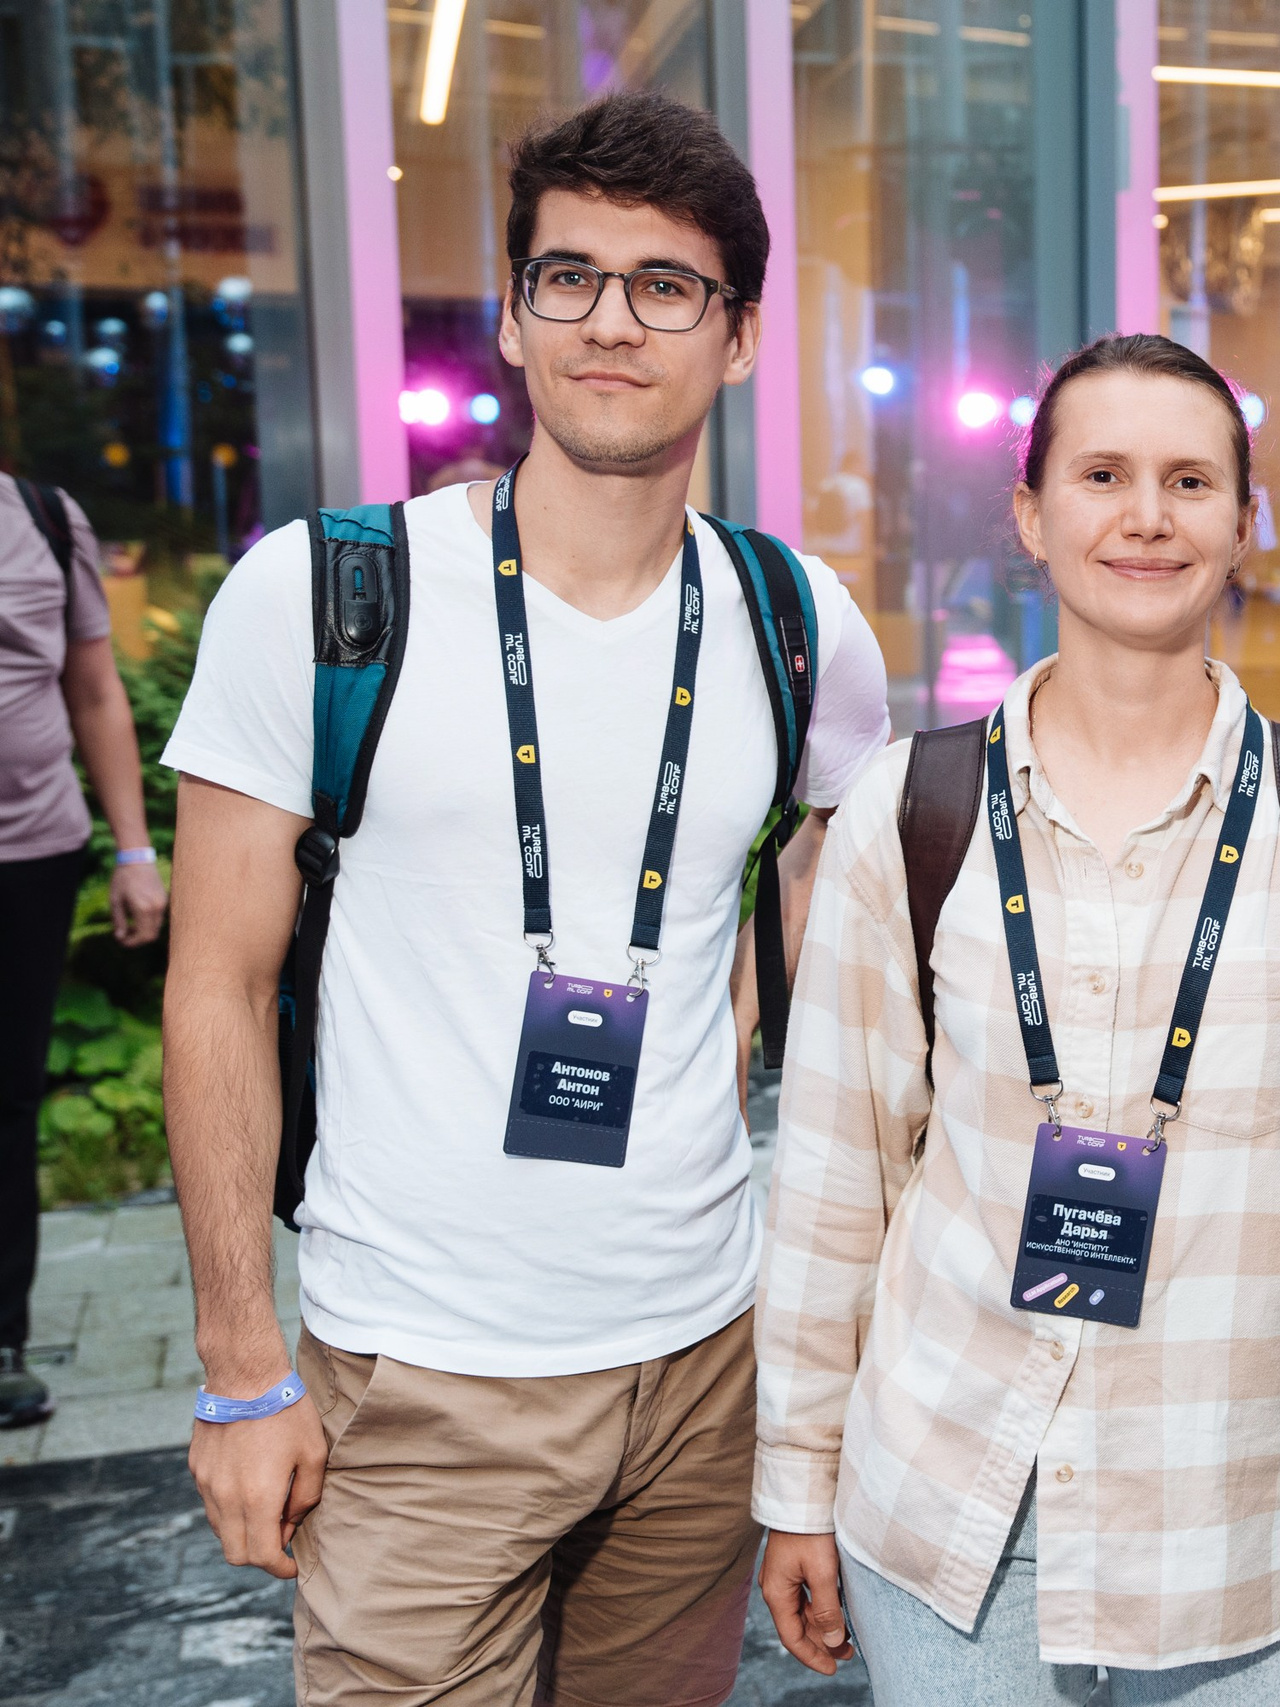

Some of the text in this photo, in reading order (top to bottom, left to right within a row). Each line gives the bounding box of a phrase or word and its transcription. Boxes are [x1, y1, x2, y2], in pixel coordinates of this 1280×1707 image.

[684, 584, 692, 631] TURBO
[514, 633, 527, 686] TURBO
[1238, 750, 1252, 793] TURBO
[658, 761, 673, 812] TURBO
[999, 790, 1012, 839] TURBO
[532, 824, 542, 878] TURBO
[1193, 917, 1212, 968] TURBO
[1026, 970, 1042, 1026] TURBO
[552, 1062, 610, 1081] Антонов
[557, 1079, 600, 1096] Антон
[549, 1095, 603, 1111] ООО "АИРИ"
[1083, 1168, 1110, 1177] Участник
[1053, 1203, 1122, 1226] Пугачёва
[1055, 1238, 1070, 1246] АНО
[1060, 1222, 1108, 1240] Дарья
[1026, 1241, 1090, 1258] ИСКУССТВЕННОГО
[1058, 1286, 1075, 1304] Research
